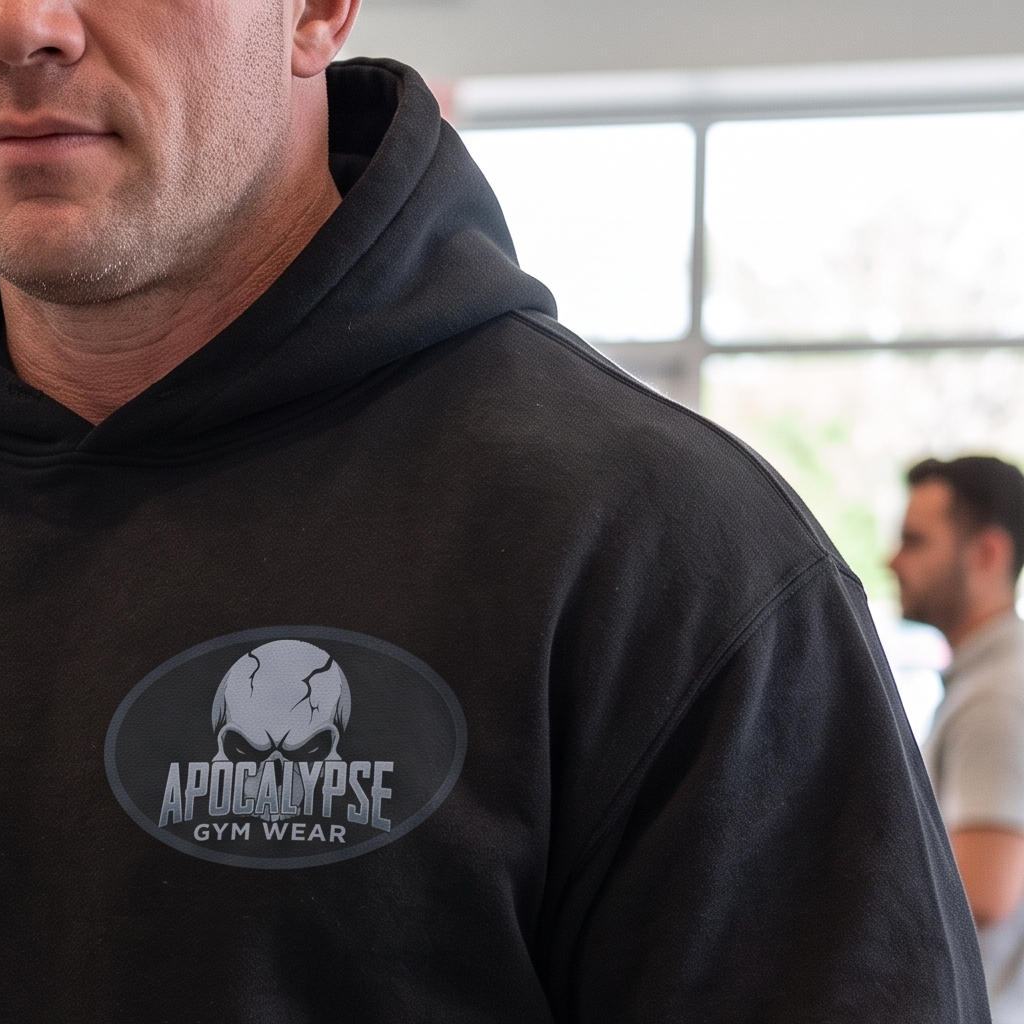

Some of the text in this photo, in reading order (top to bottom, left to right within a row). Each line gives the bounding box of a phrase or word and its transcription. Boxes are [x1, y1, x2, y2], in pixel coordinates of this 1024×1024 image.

[158, 760, 394, 832] APOCALYPSE
[193, 822, 346, 843] GYM WEAR
